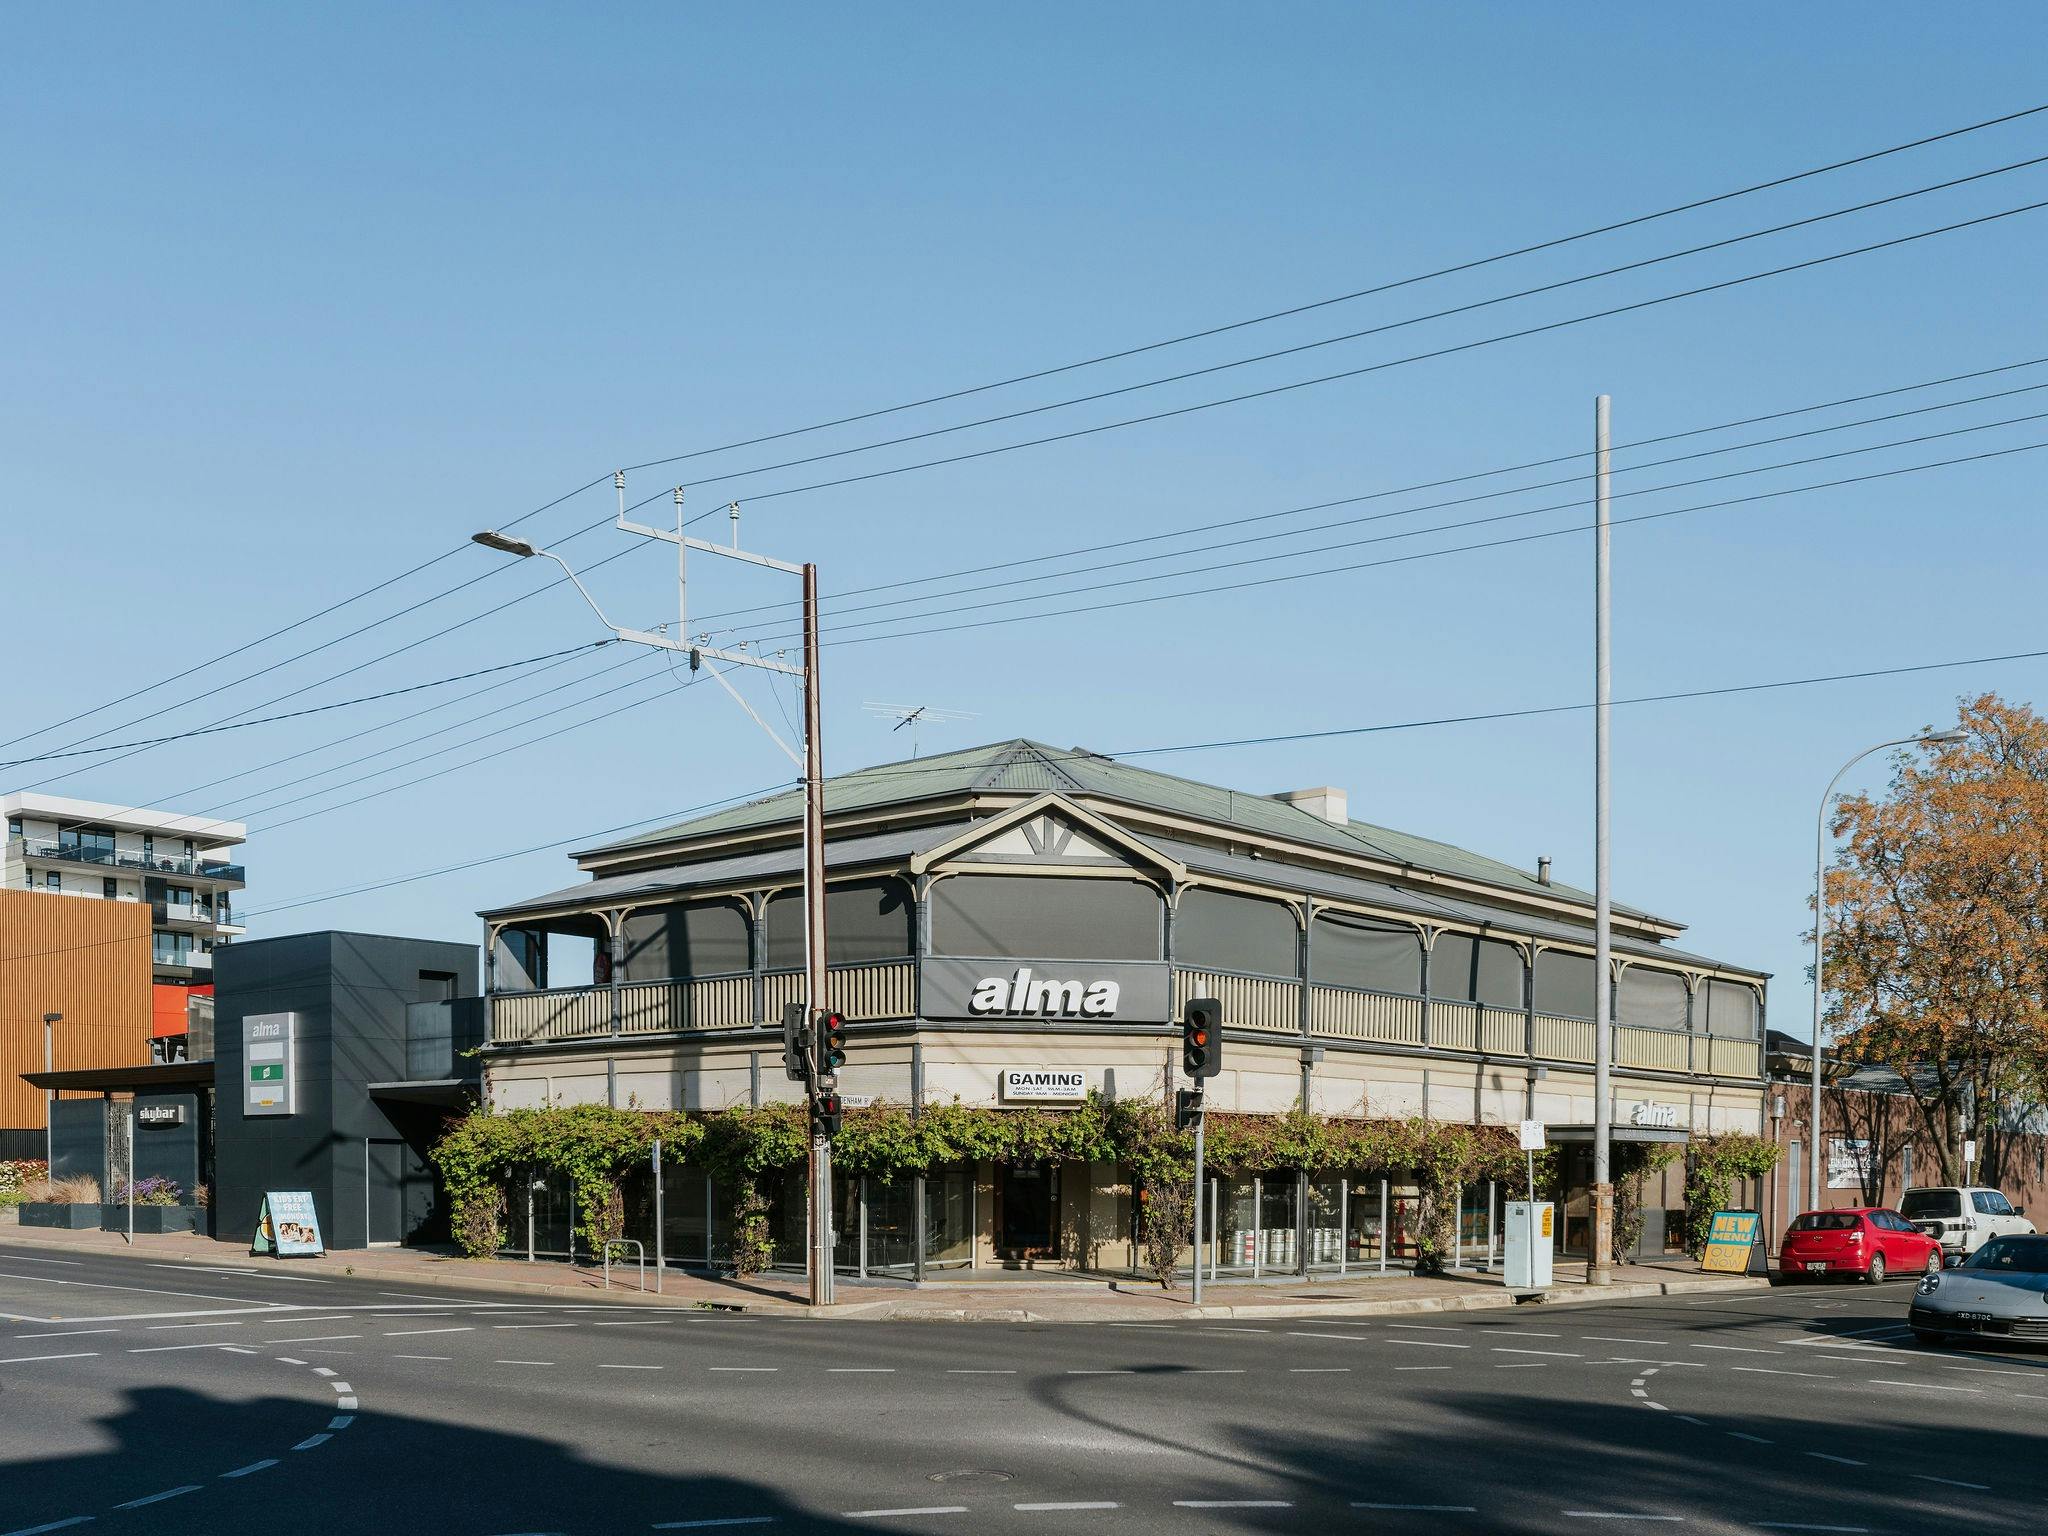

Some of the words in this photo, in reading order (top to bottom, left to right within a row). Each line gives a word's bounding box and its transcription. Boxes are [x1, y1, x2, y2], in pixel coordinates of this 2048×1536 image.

[971, 967, 1121, 1015] alma
[252, 1021, 280, 1037] alma
[1009, 1073, 1083, 1086] GAMING
[139, 1106, 176, 1122] skybar
[1636, 1099, 1676, 1127] alma
[1714, 1216, 1755, 1232] NEW
[1711, 1232, 1752, 1242] MENU
[1711, 1247, 1746, 1258] OUT
[1710, 1258, 1742, 1268] NOW
